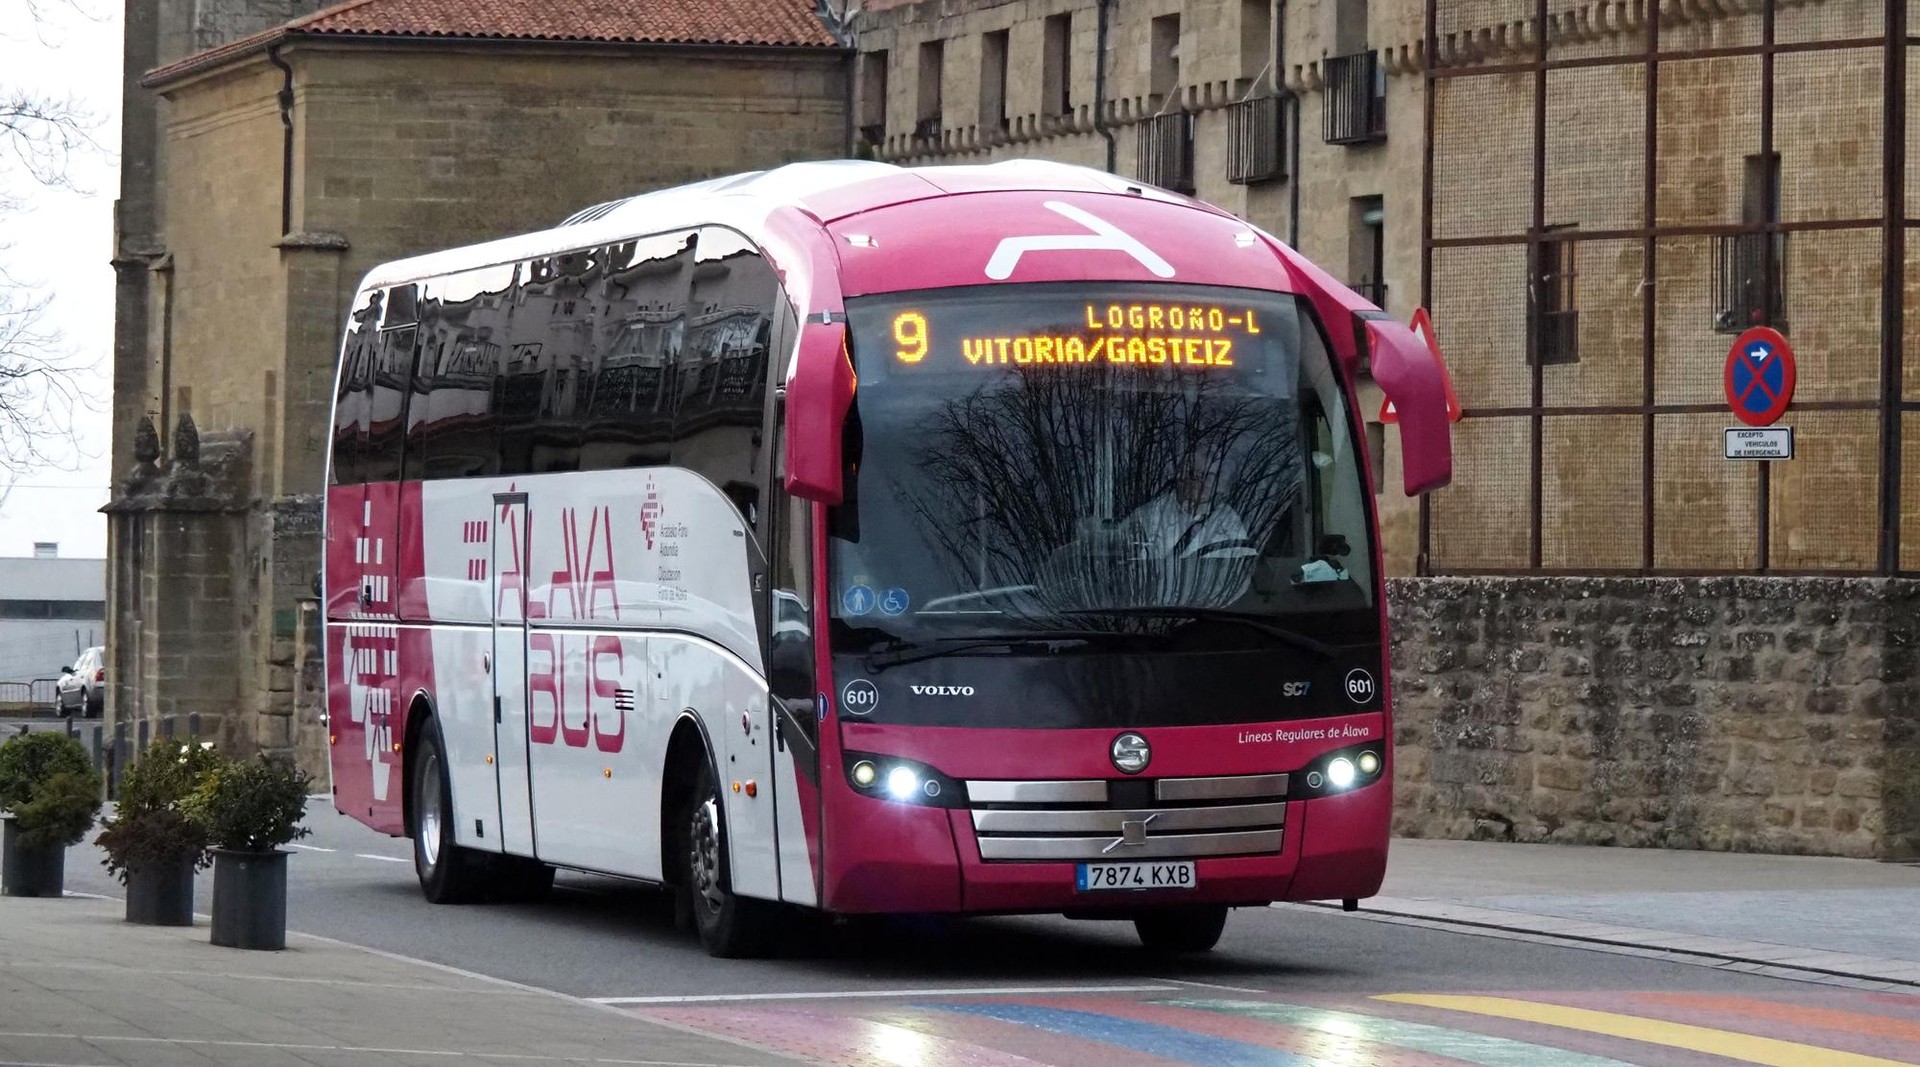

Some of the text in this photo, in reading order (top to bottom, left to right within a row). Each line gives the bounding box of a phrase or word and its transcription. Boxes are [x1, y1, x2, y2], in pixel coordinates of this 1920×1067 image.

[893, 312, 929, 363] 9
[962, 336, 1234, 367] VITORIA/GASTEIZ
[498, 482, 620, 621] ÁLAVA
[529, 632, 626, 754] BUS
[910, 685, 975, 697] VOLVO
[1282, 681, 1311, 697] SC7
[1348, 679, 1372, 694] 601
[846, 690, 875, 705] 601
[1238, 723, 1369, 744] Líneas Regulares de Álava
[1091, 866, 1144, 887] 7874
[1151, 865, 1190, 885] KXB
